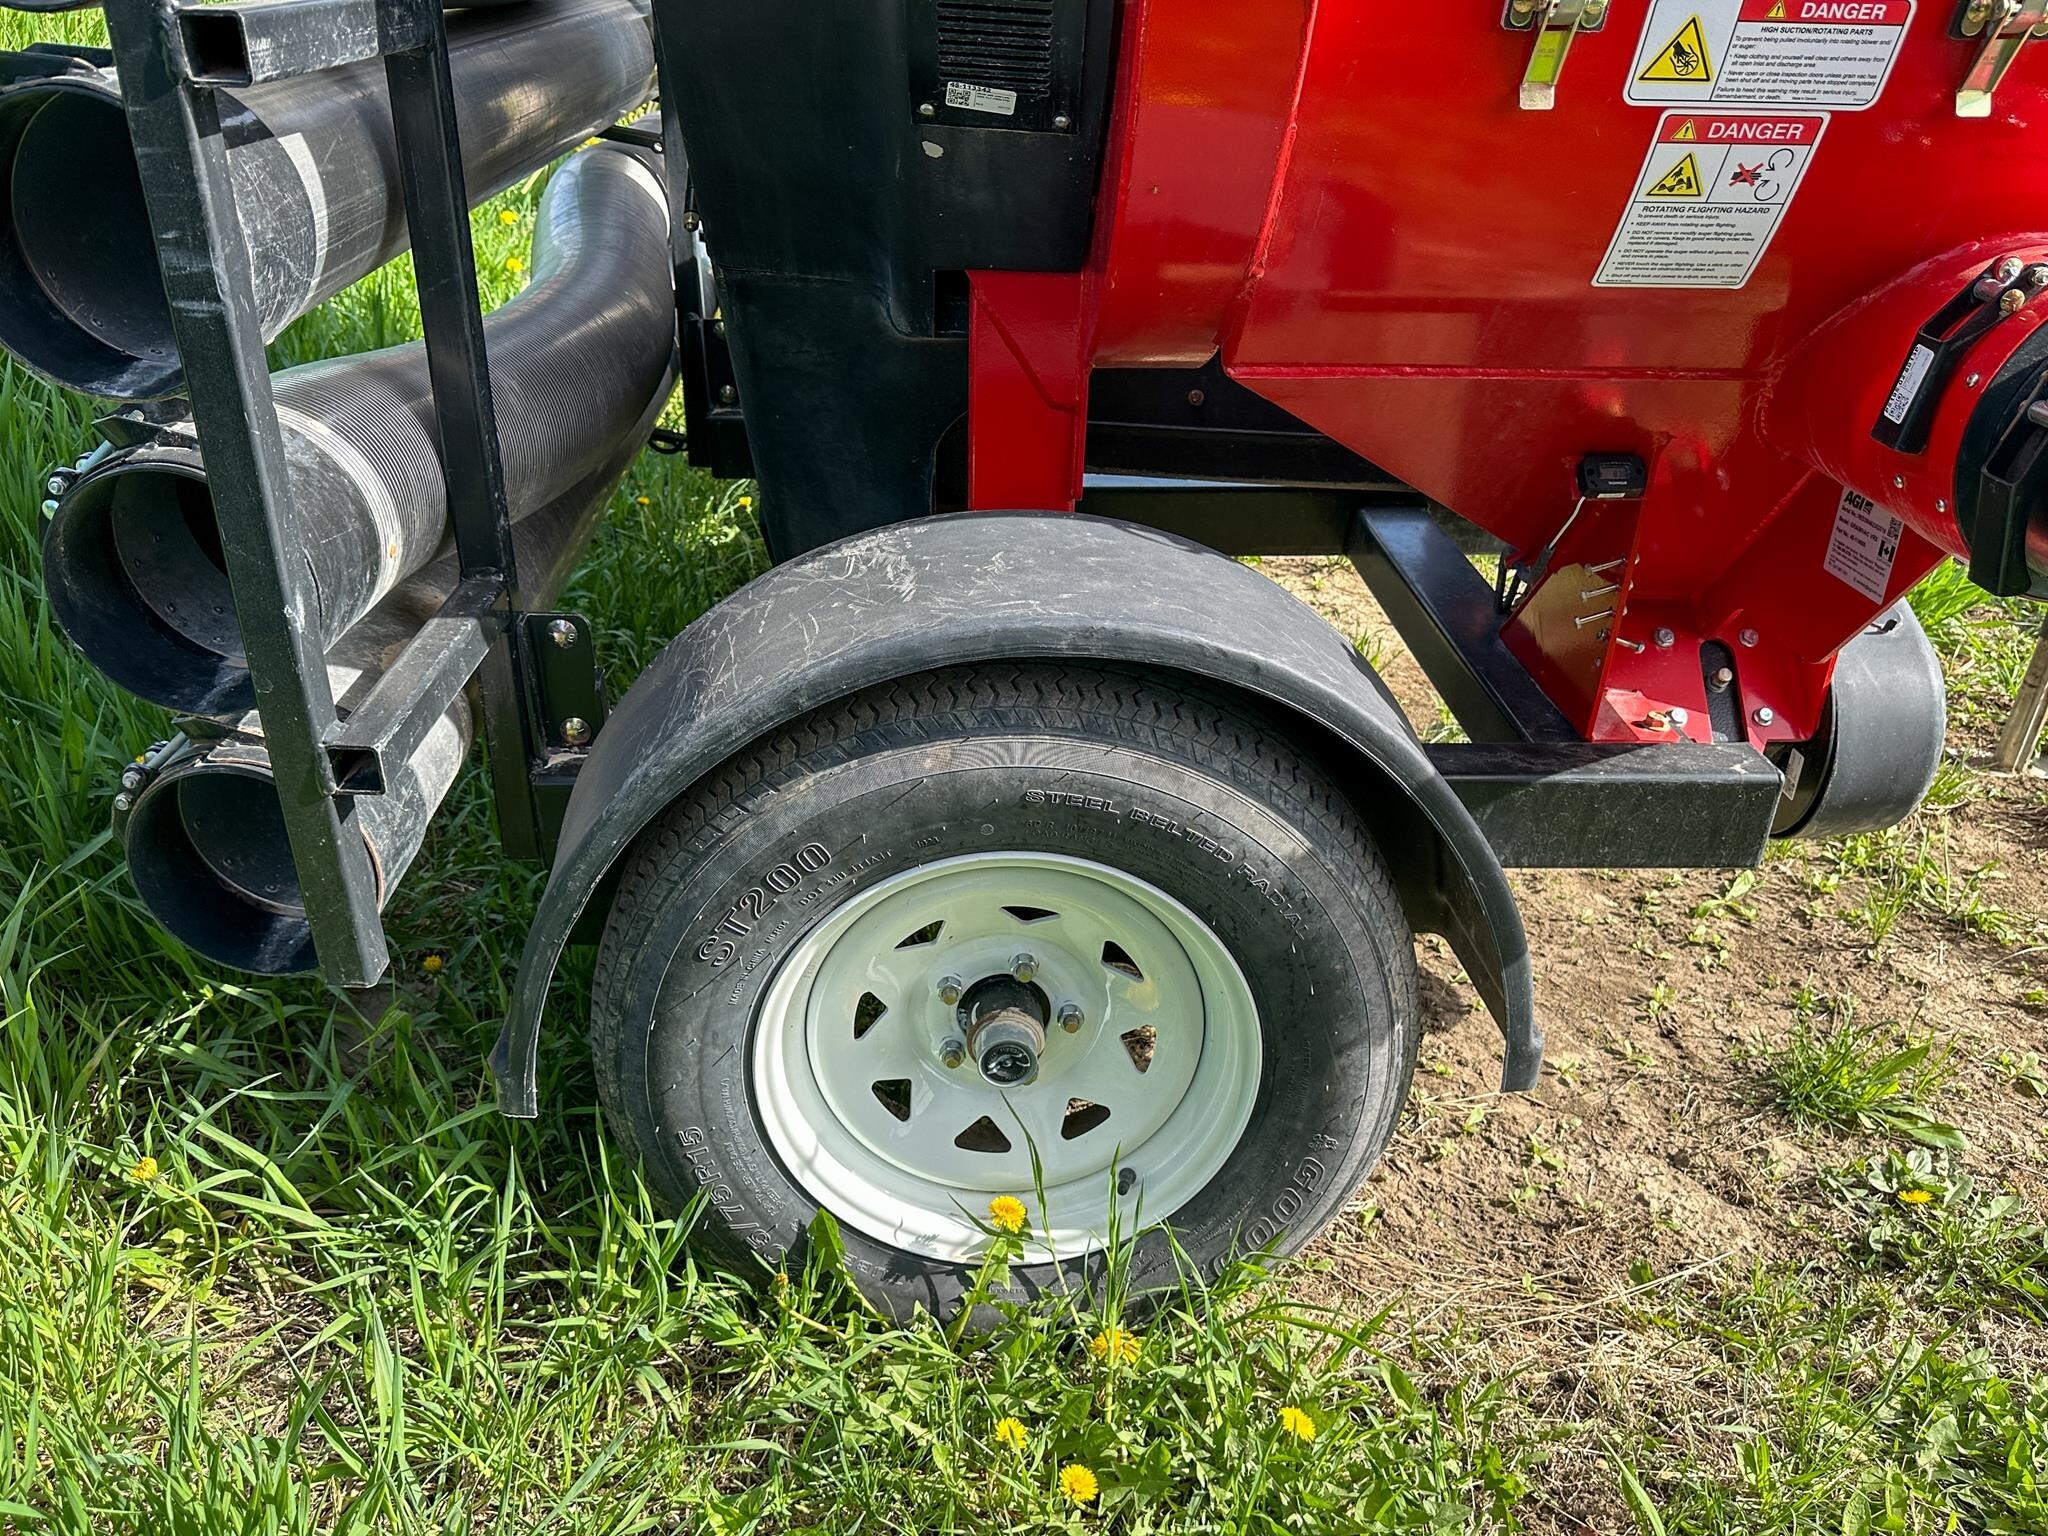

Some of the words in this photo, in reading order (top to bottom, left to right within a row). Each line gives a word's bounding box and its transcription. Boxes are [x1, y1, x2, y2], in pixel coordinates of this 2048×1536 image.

[1800, 2, 1887, 20] DANGER
[1780, 27, 1849, 35] SUCTION/ROTATING
[1850, 28, 1874, 36] PARTS
[1707, 122, 1804, 140] DANGER
[1642, 205, 1685, 213] ROTATING
[1687, 206, 1733, 214] FLIGHTING
[1844, 490, 1865, 510] AGI
[1025, 789, 1120, 814] STEEL
[1130, 807, 1234, 863] BELTED
[1237, 862, 1309, 941] RADIAL
[698, 842, 832, 968] ST200
[678, 1126, 800, 1276] 05/75R15
